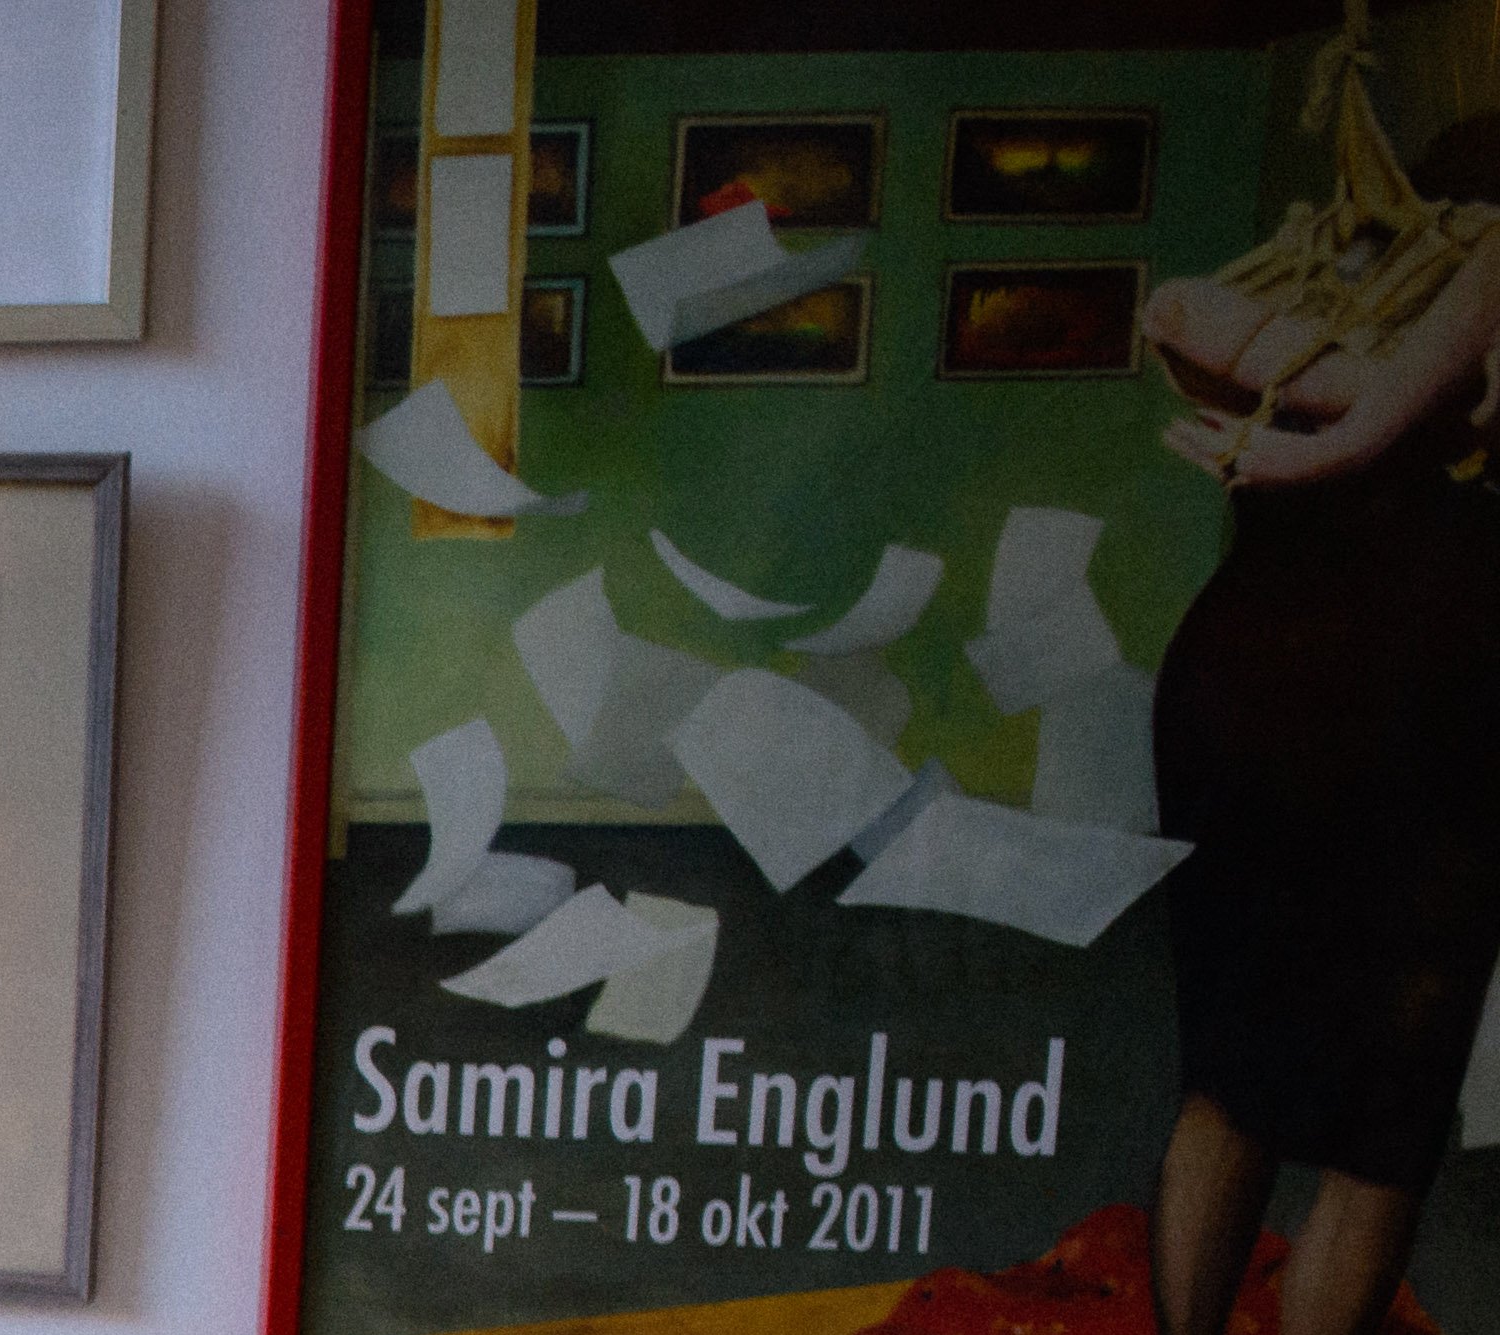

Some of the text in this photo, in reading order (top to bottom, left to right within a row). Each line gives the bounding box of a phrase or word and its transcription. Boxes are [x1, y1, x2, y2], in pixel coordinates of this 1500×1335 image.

[352, 1024, 1067, 1178] Samira Englund
[342, 1162, 407, 1232] 24
[426, 1179, 537, 1254] sept
[623, 1174, 682, 1245] 18
[701, 1173, 789, 1250] okt
[806, 1181, 934, 1255] 2011
